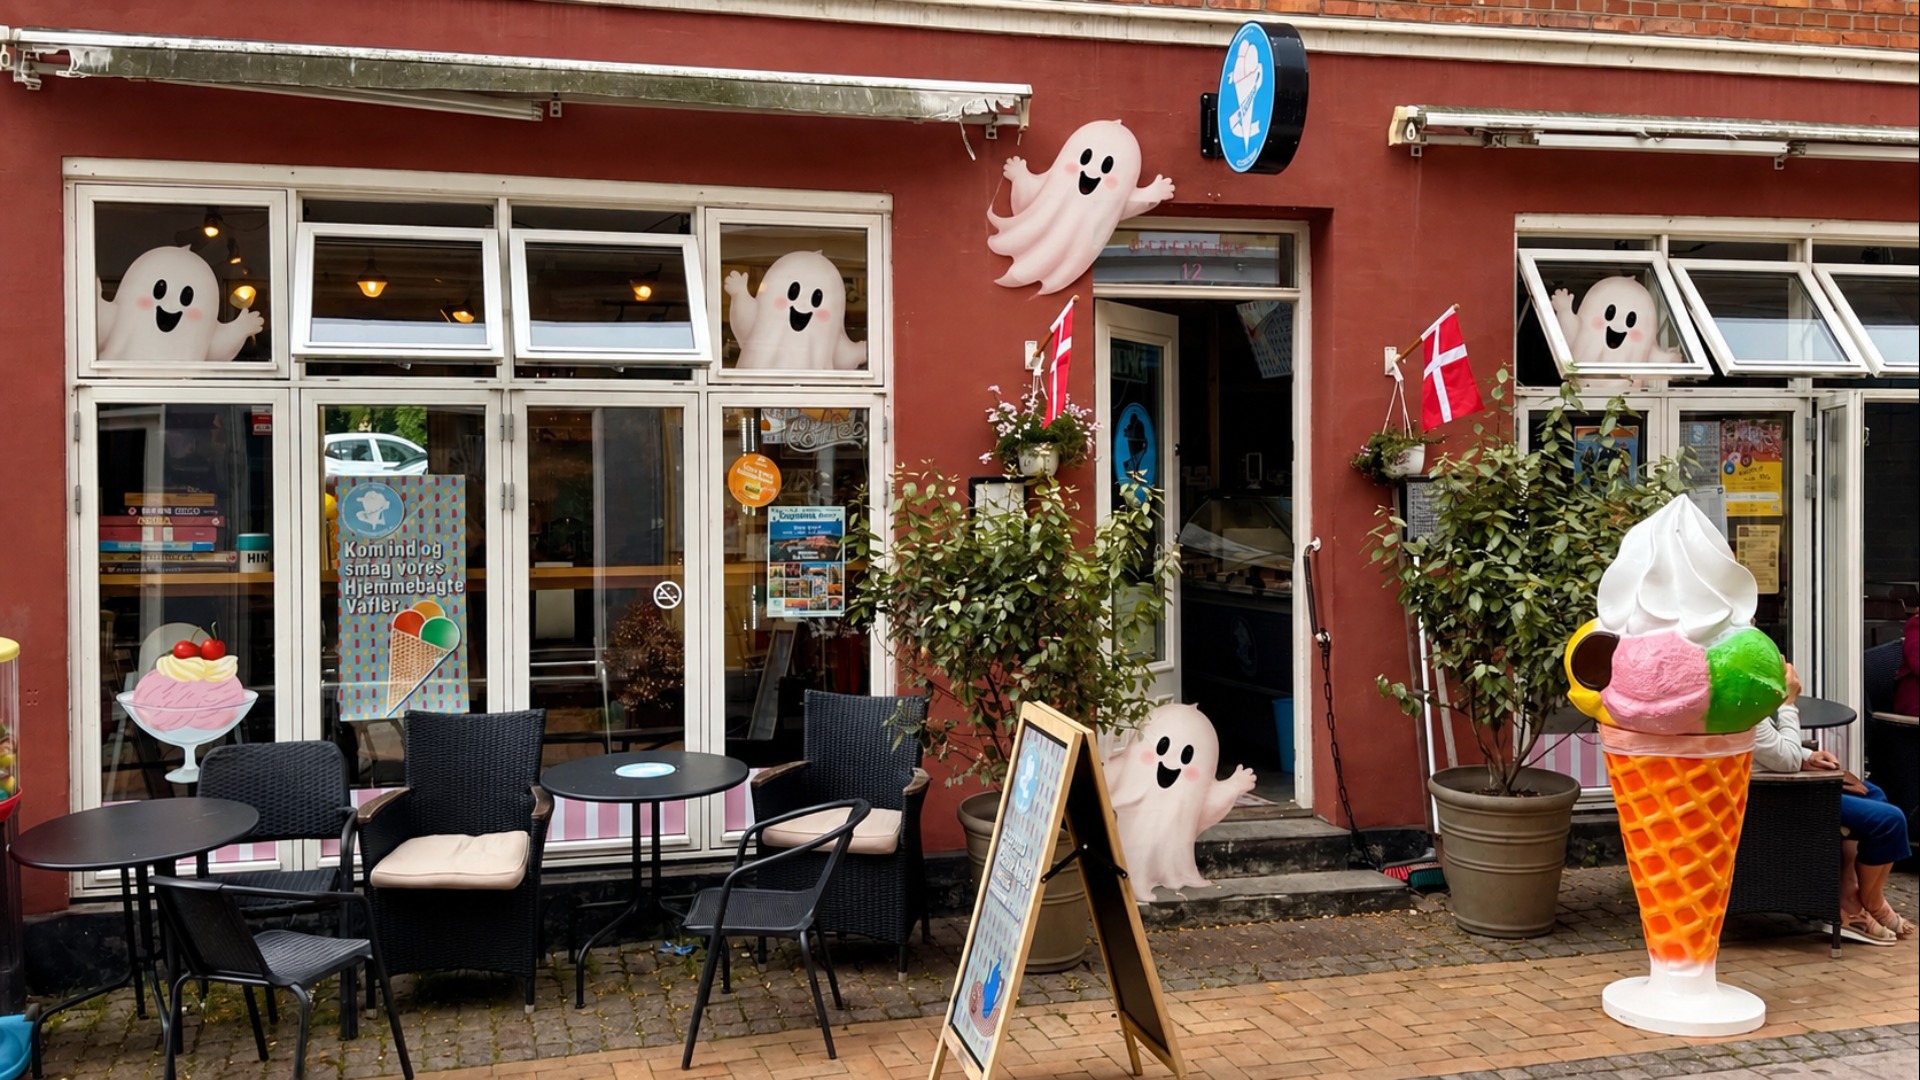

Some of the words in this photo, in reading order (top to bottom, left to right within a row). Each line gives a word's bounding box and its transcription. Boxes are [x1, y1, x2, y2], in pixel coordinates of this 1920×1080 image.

[1182, 262, 1202, 281] 12
[344, 541, 385, 558] Kom
[388, 540, 417, 558] ind
[421, 542, 443, 560] og
[344, 562, 392, 579] smag
[397, 561, 446, 576] vores
[345, 577, 464, 598] Hjemmebagte
[346, 598, 400, 614] Vafler
